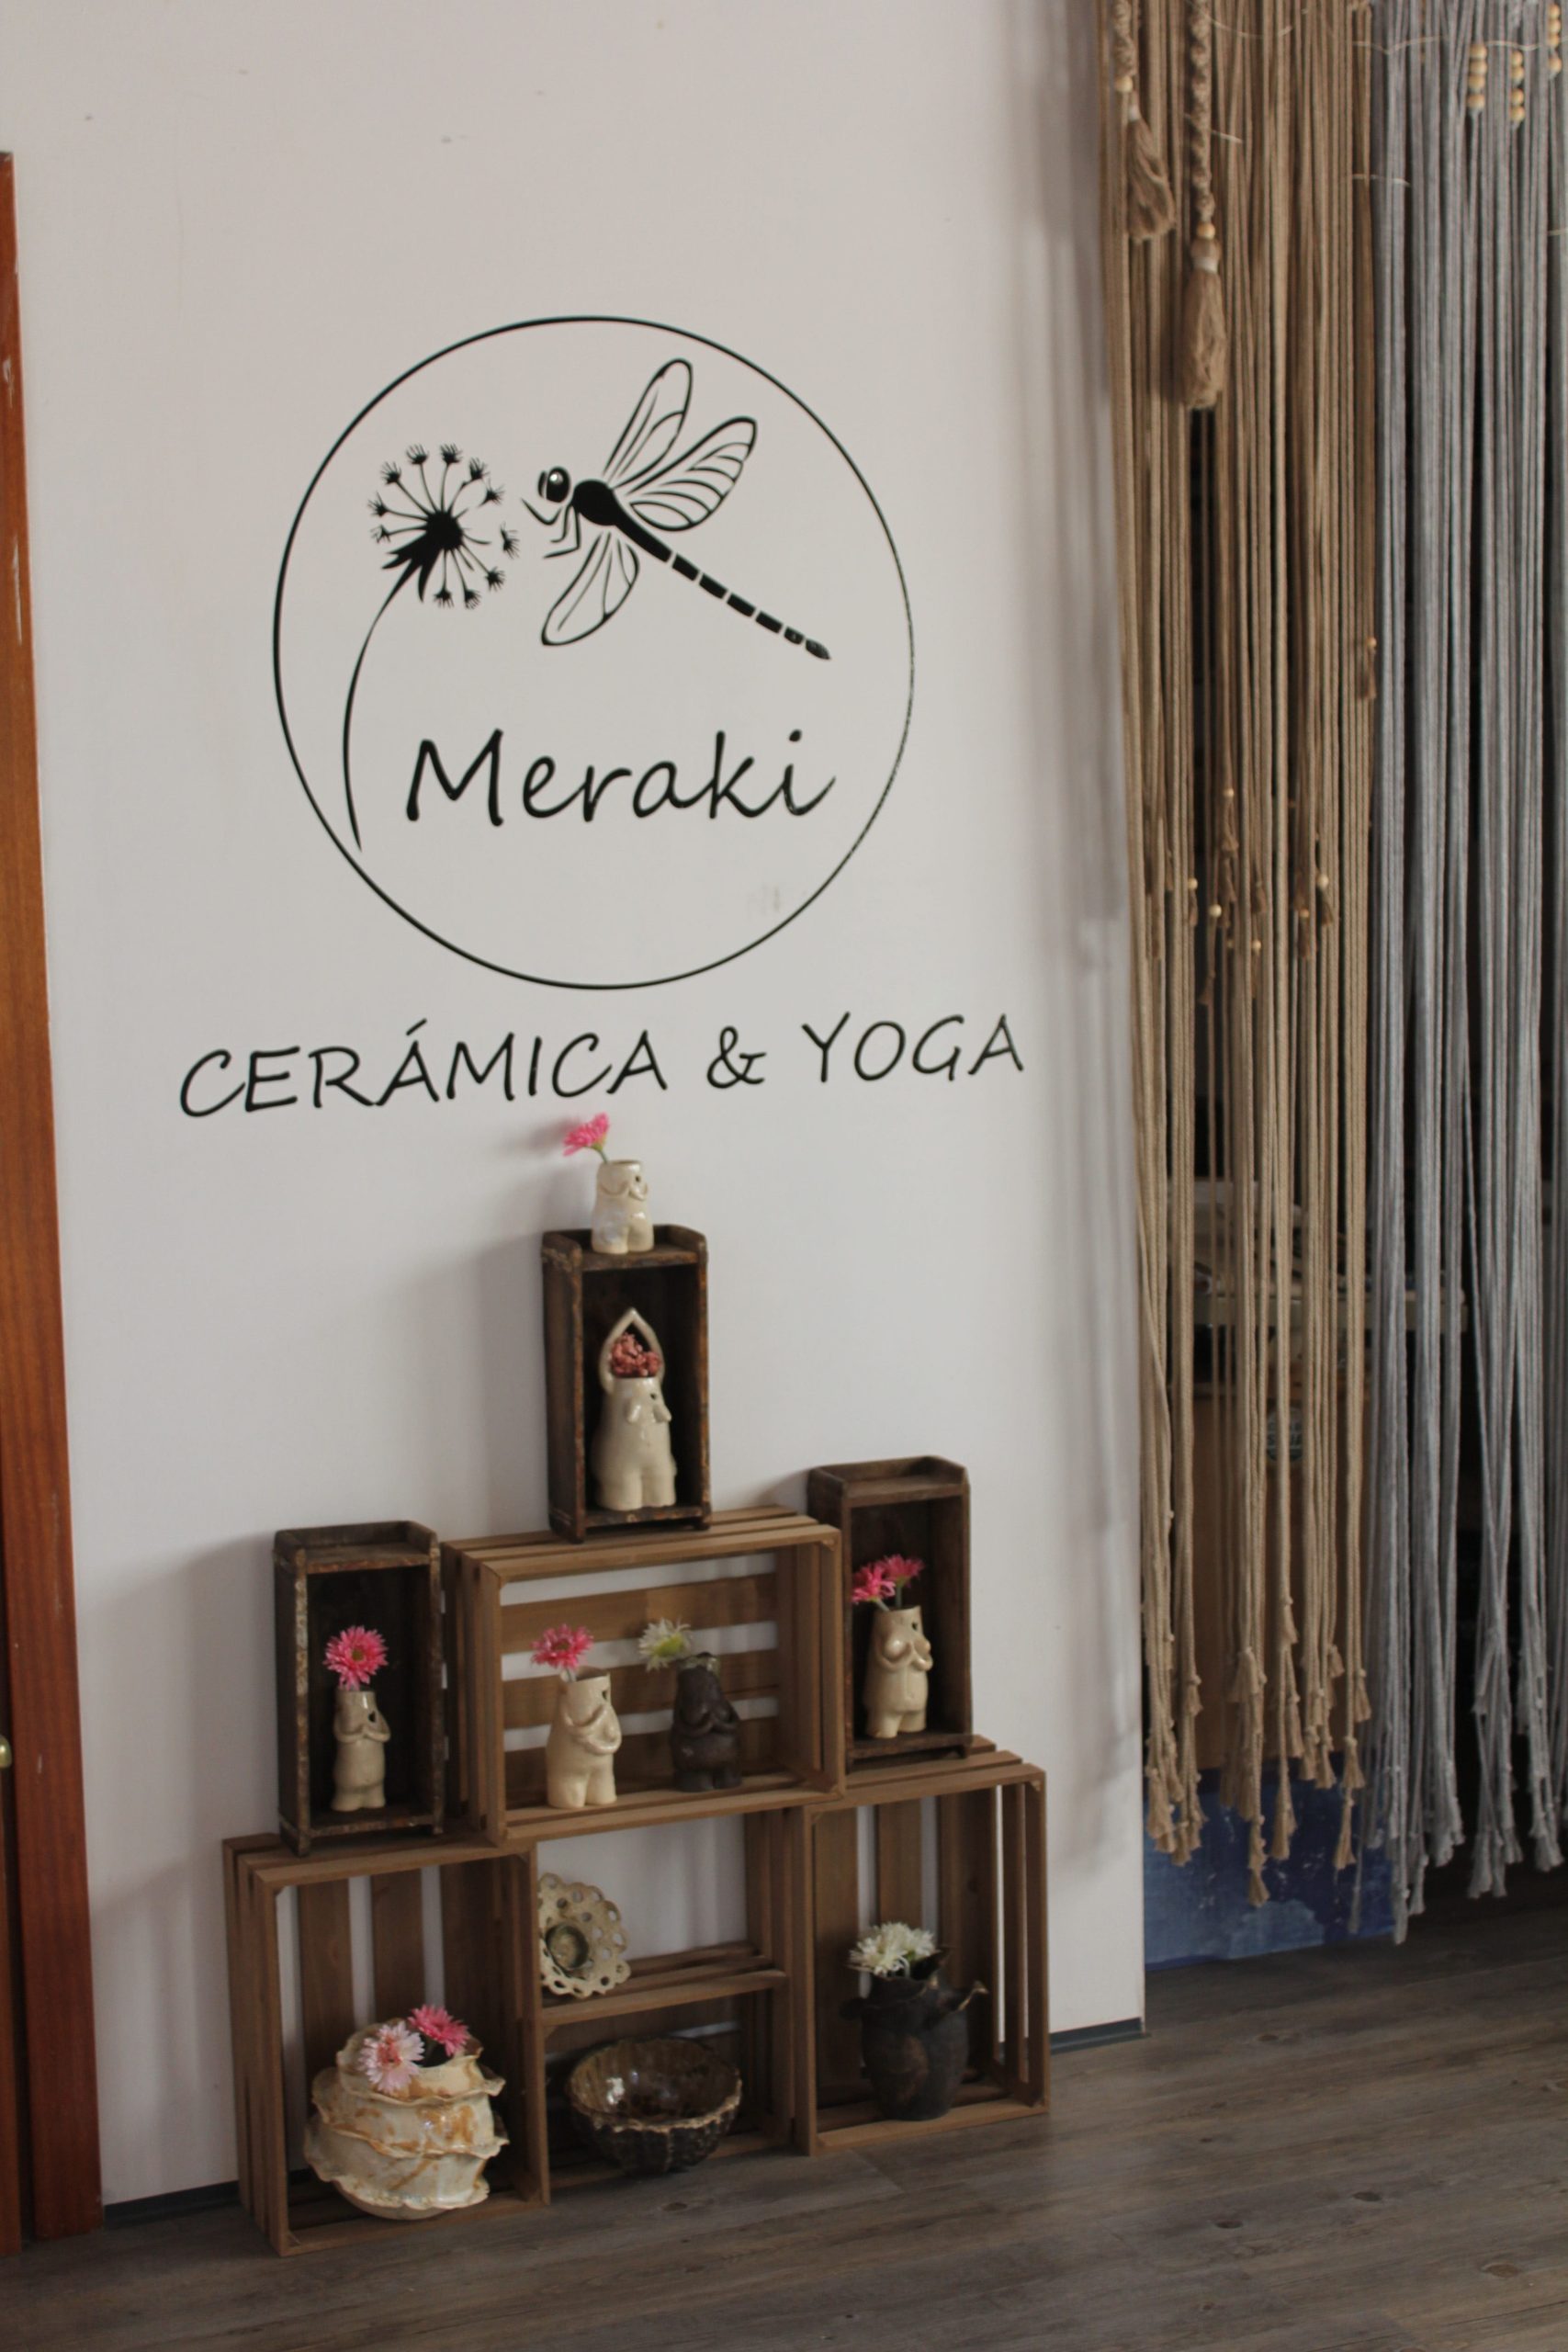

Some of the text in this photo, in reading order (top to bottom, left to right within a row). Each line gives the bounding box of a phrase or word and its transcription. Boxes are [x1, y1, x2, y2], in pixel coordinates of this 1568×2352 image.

[406, 728, 835, 827] Meraki
[179, 1012, 1024, 1118] CERÁMICA & YOGA
